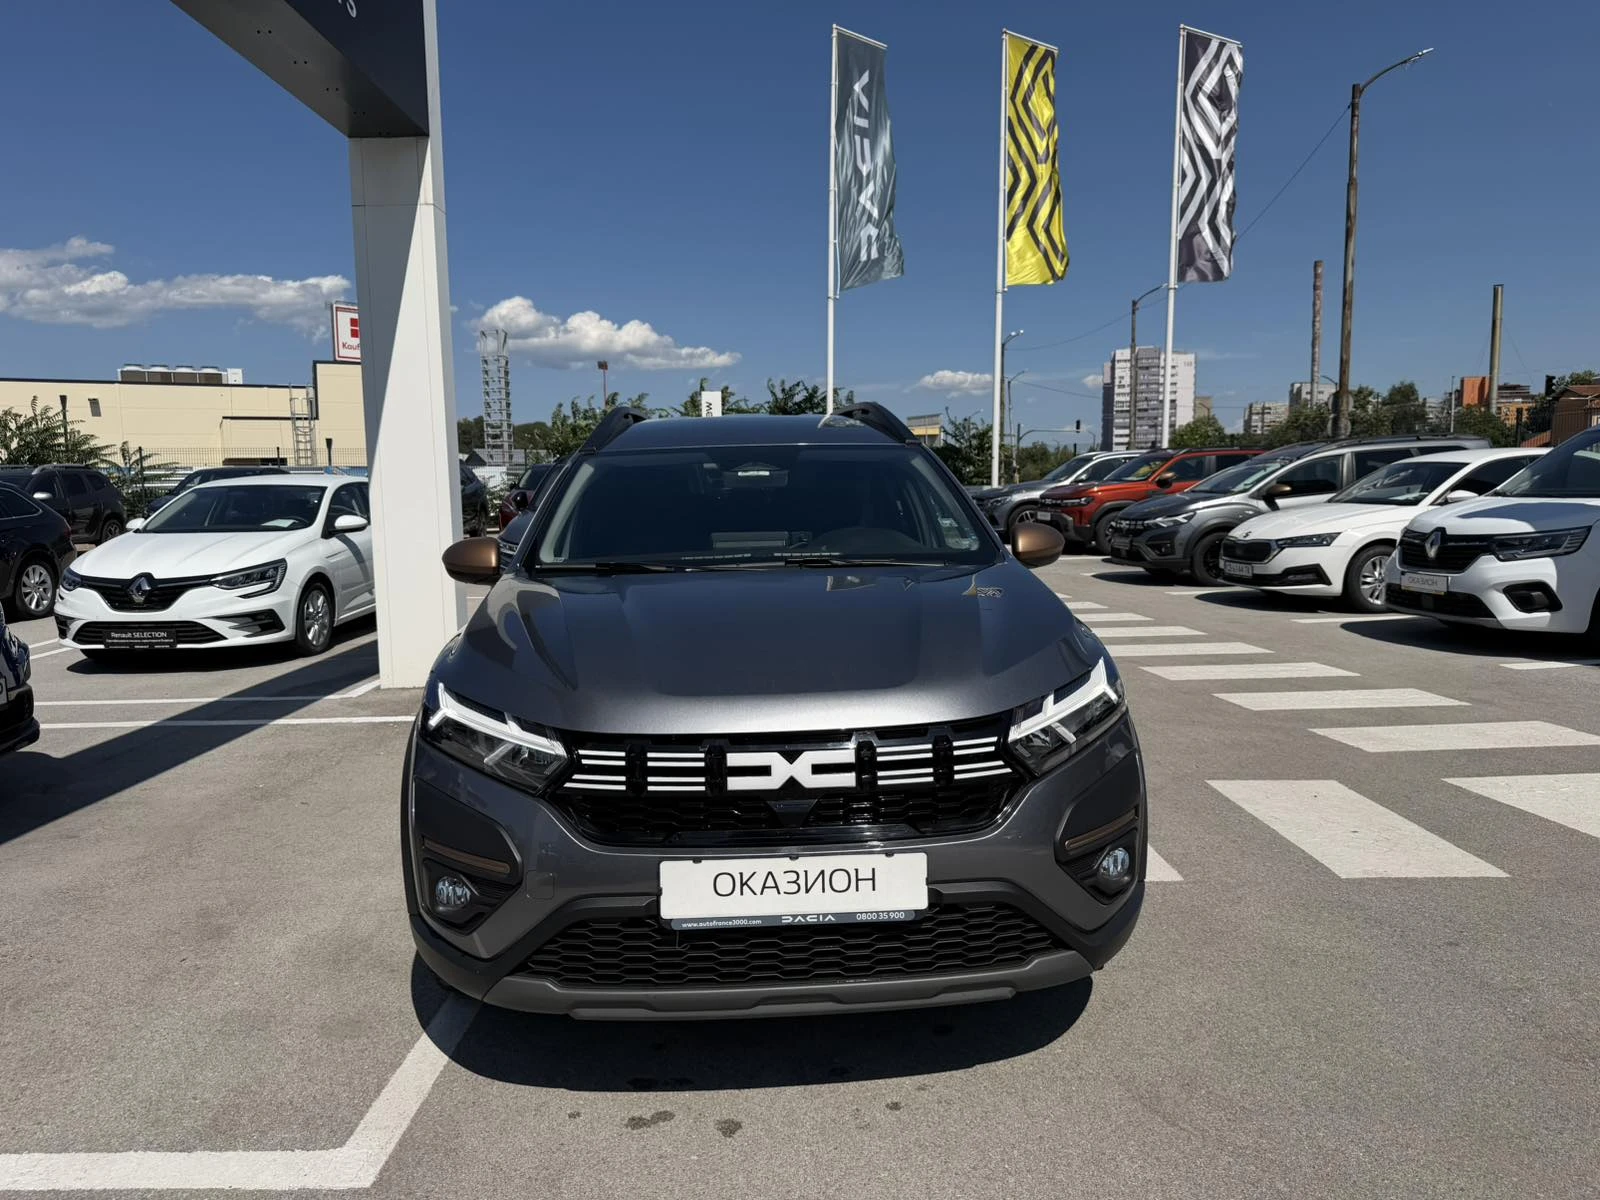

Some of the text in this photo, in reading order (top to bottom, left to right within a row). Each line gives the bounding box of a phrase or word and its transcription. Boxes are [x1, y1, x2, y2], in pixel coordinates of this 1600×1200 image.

[712, 867, 877, 897] ОКАЗИОН
[781, 914, 836, 923] DACIA
[856, 911, 905, 921] 0800 35 900
[681, 919, 762, 928] www.autofrance3000.com
